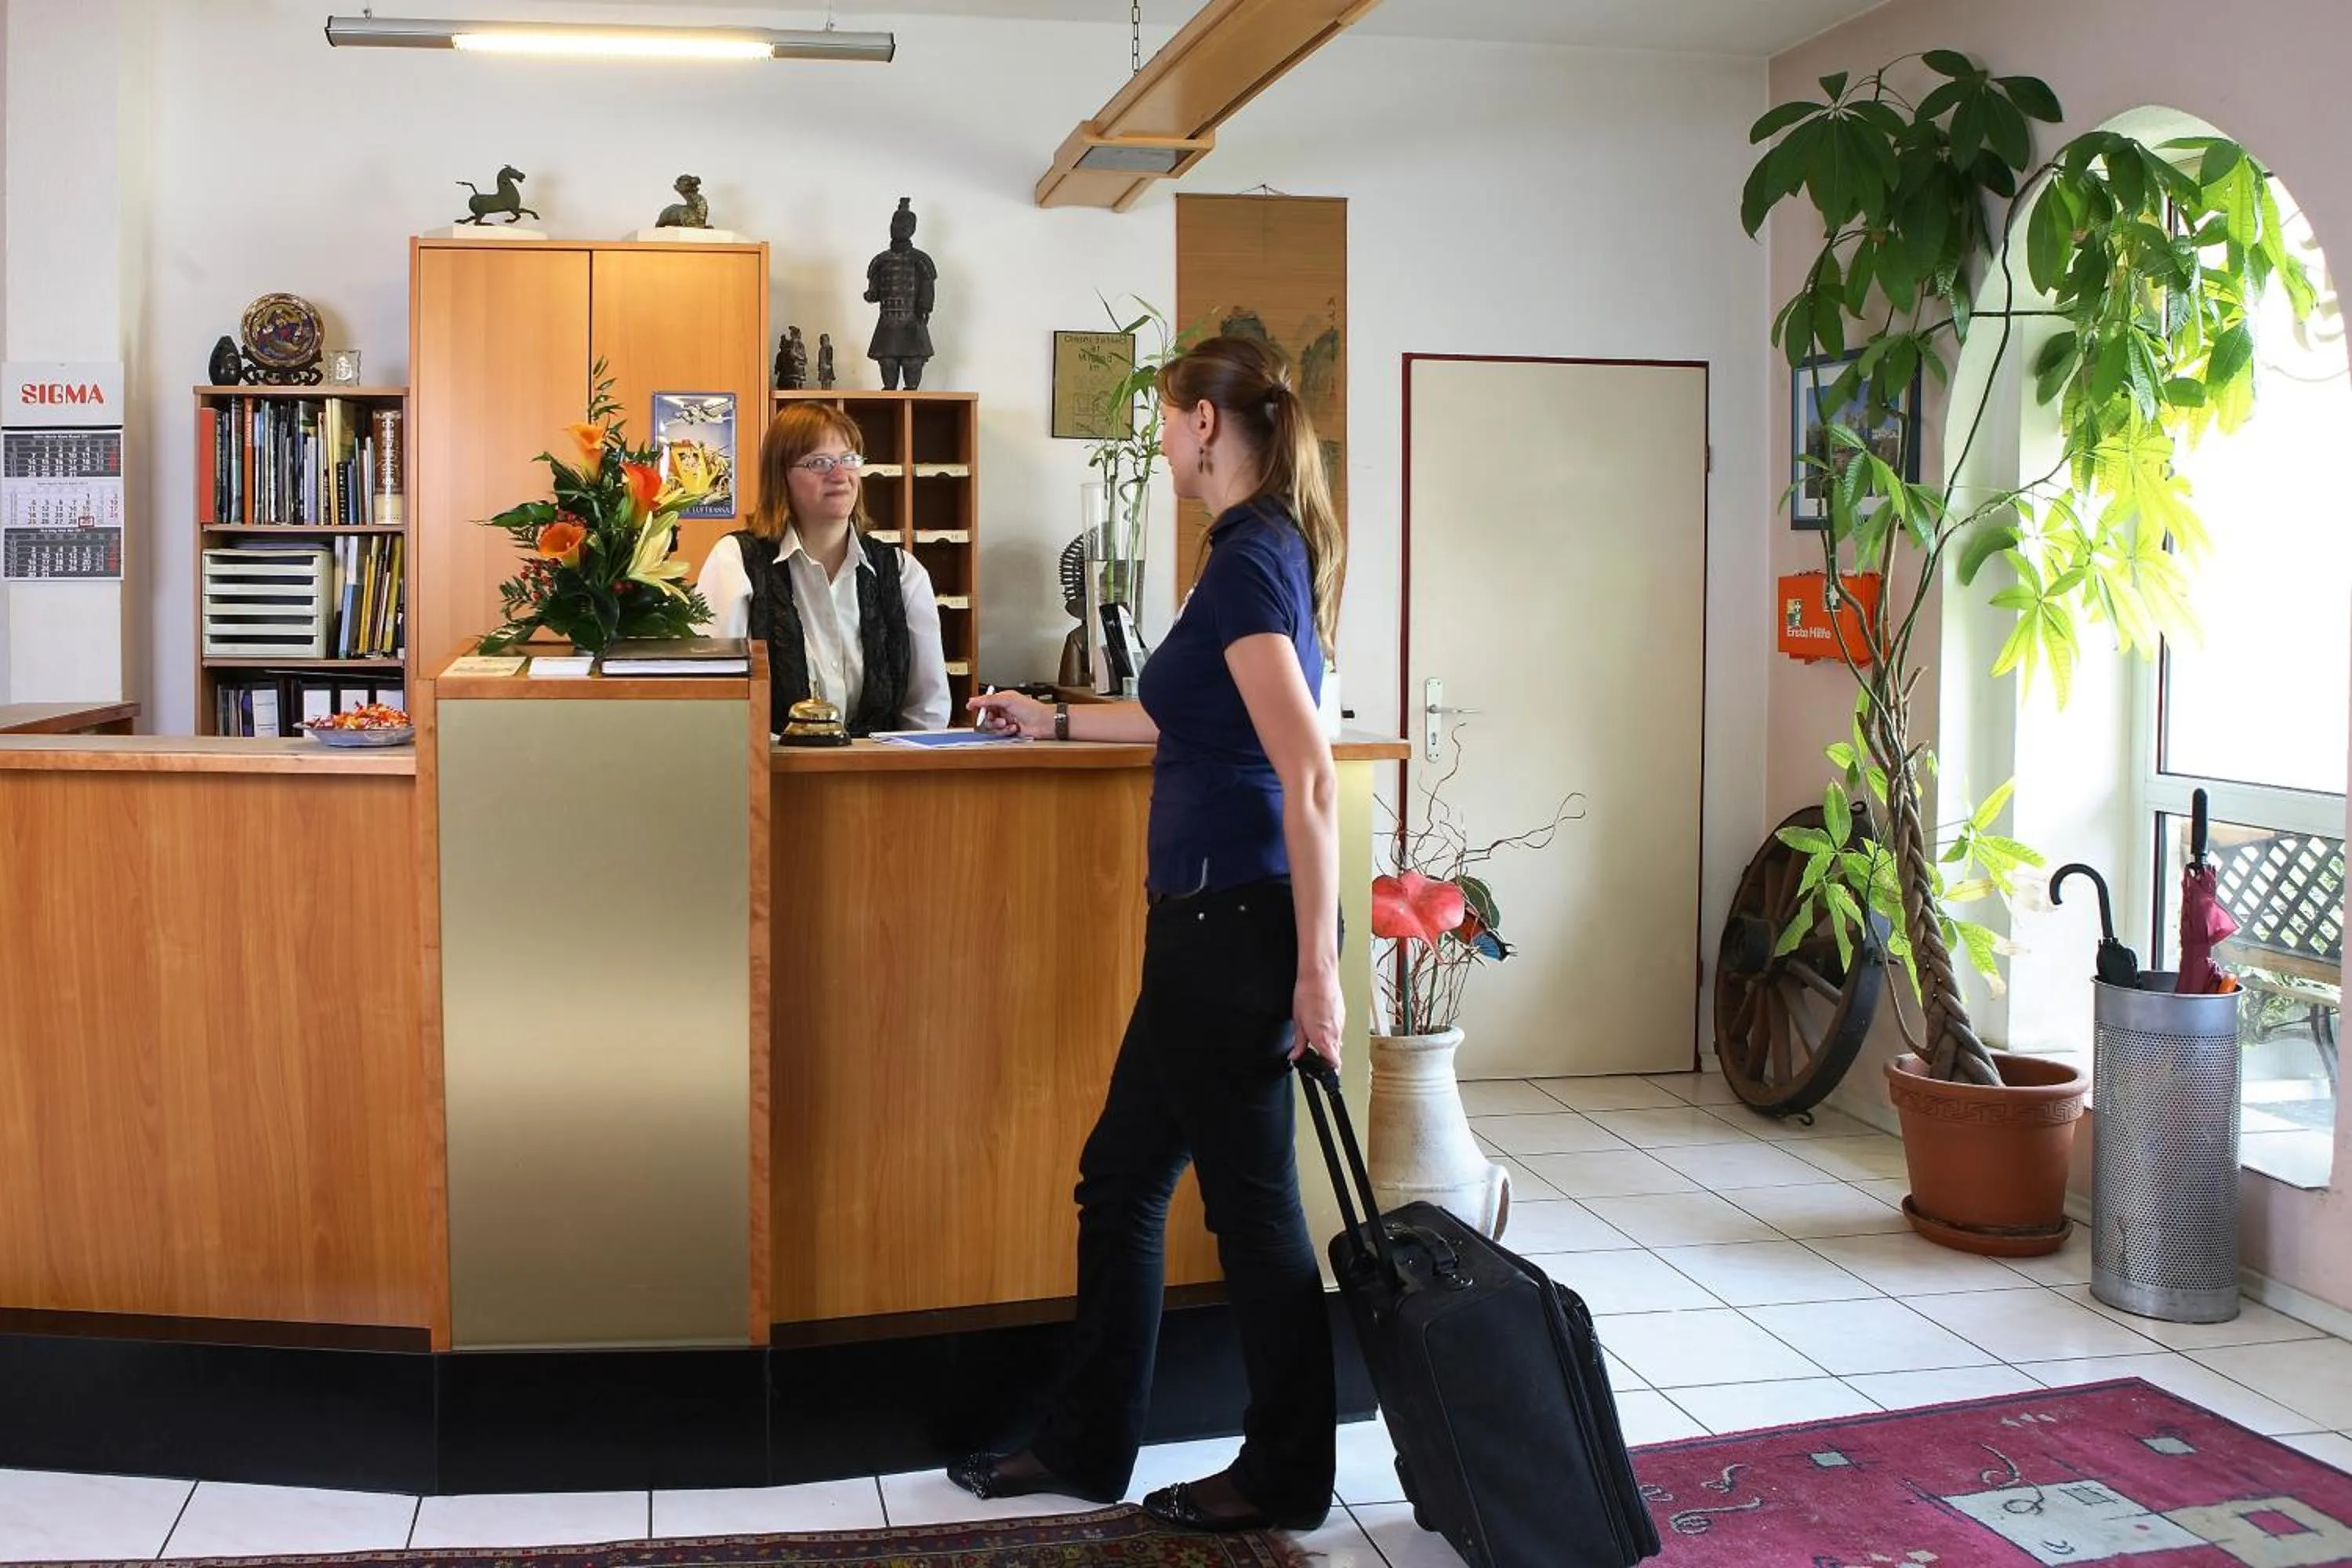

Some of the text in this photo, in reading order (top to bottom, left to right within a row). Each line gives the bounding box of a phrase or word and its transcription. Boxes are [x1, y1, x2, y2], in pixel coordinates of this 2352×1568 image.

[21, 383, 104, 404] SIGMA
[1787, 626, 1831, 639] Erste Hilfe
